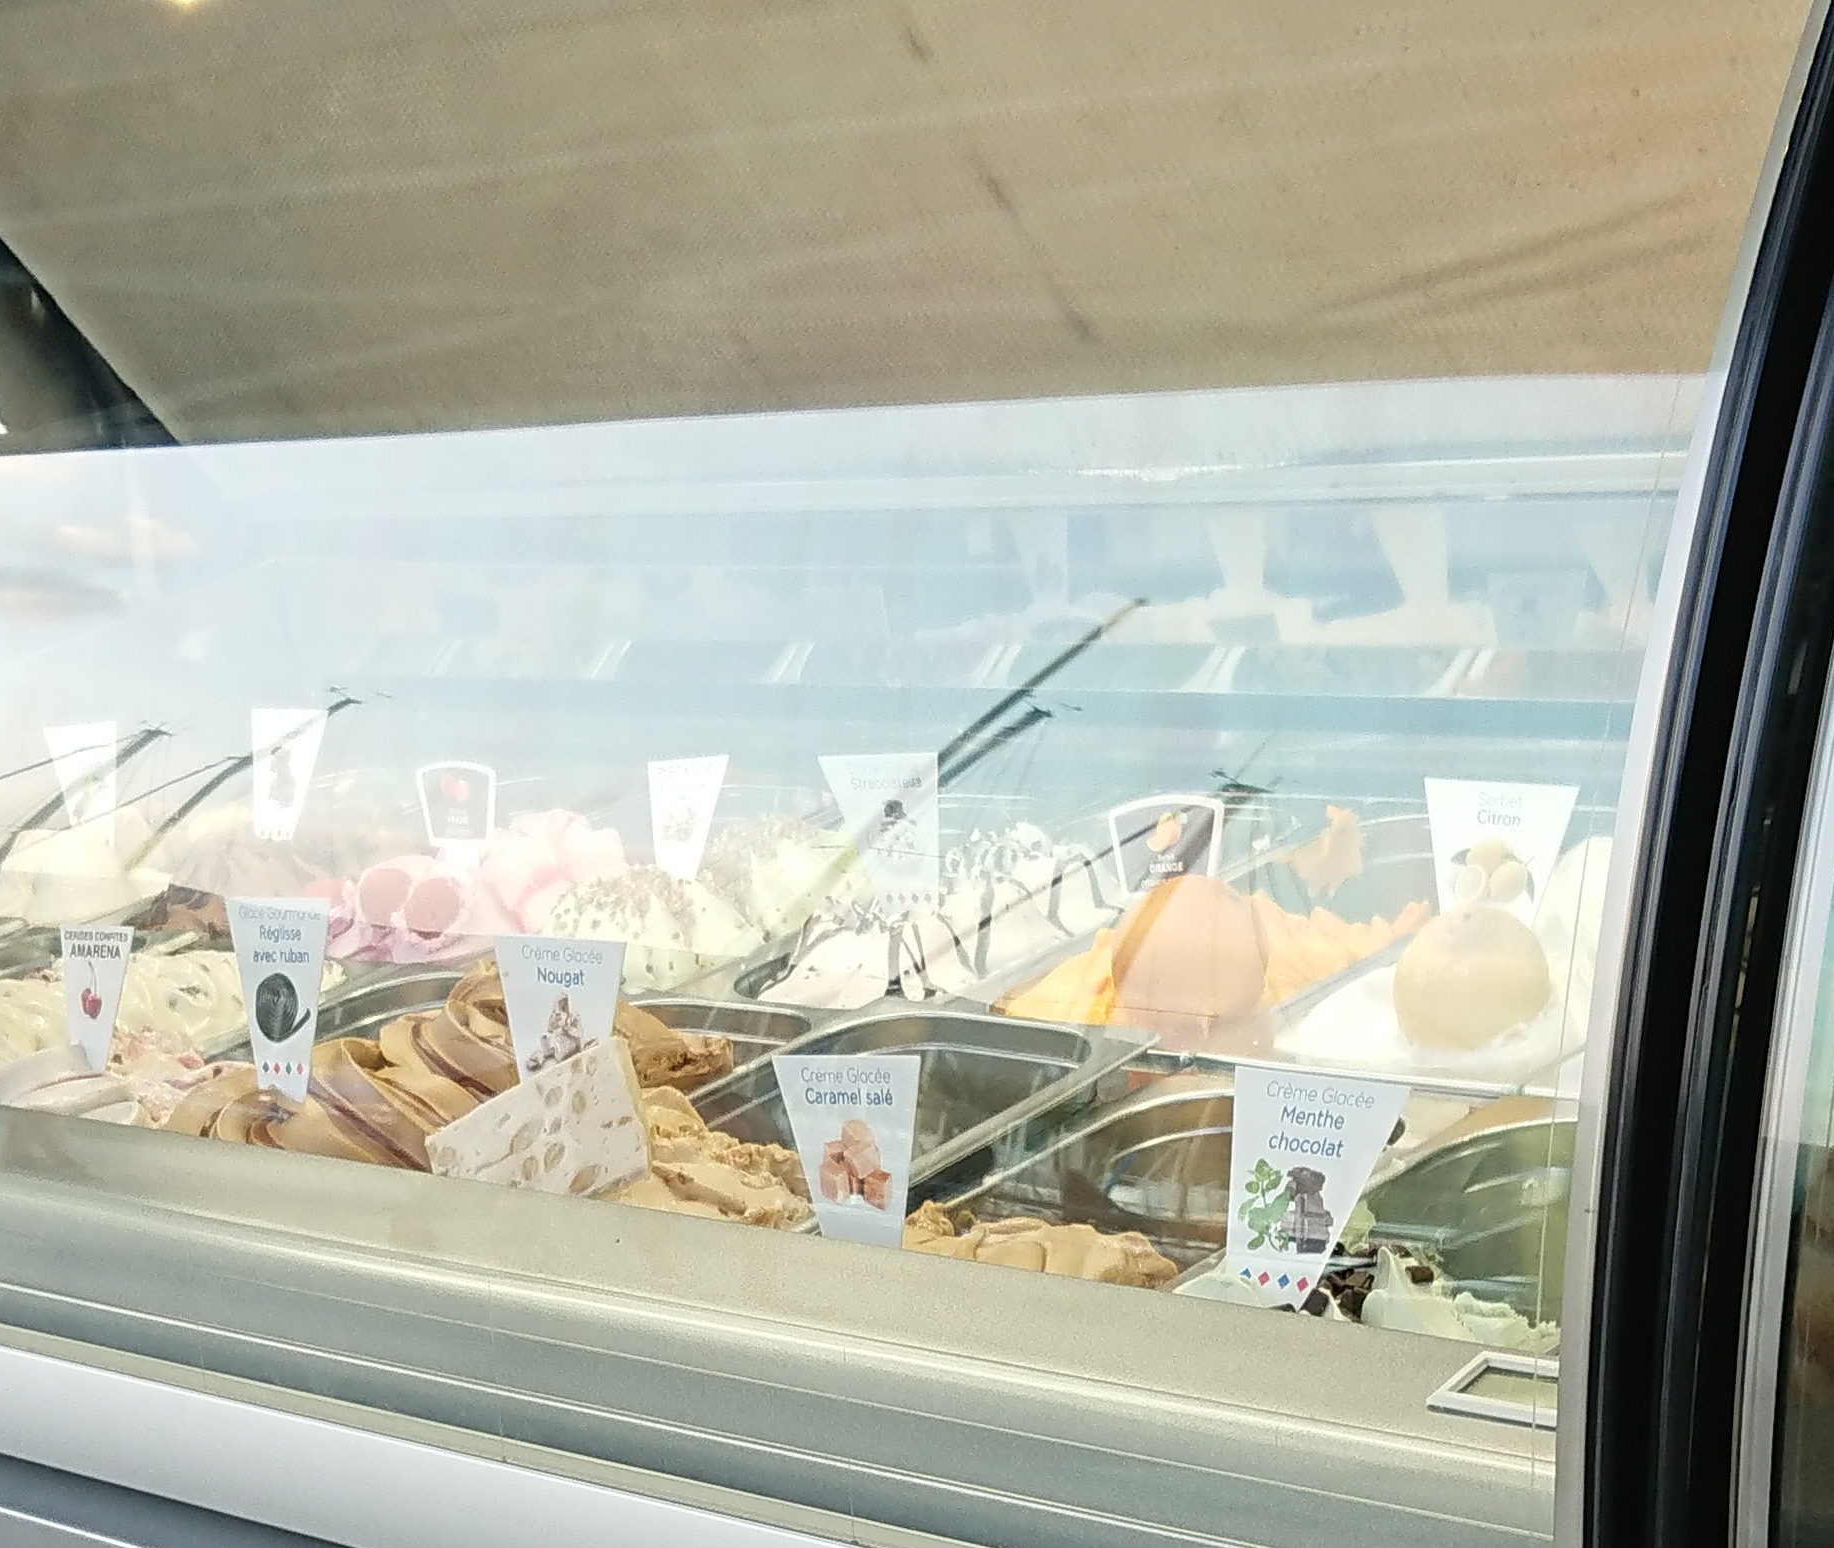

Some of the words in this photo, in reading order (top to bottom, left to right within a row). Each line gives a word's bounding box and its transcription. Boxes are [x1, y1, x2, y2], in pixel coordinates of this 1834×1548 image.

[1476, 808, 1522, 827] Citron
[1149, 861, 1184, 874] ORANGE
[238, 904, 265, 920] Glace
[259, 923, 302, 943] Réglisse
[69, 943, 122, 960] AMARENA
[252, 950, 278, 964] avec
[279, 947, 311, 964] ruban
[521, 944, 561, 962] Crème
[562, 946, 604, 965] Glacée
[536, 966, 586, 988] Nougat
[800, 1066, 844, 1084] Crème
[846, 1066, 892, 1085] Glacée
[805, 1087, 862, 1106] Caramel
[865, 1087, 894, 1106] salé
[1266, 1080, 1318, 1103] Crème
[1321, 1086, 1375, 1109] Glacée
[1280, 1105, 1345, 1131] Menthe
[1268, 1131, 1345, 1159] chocolat
